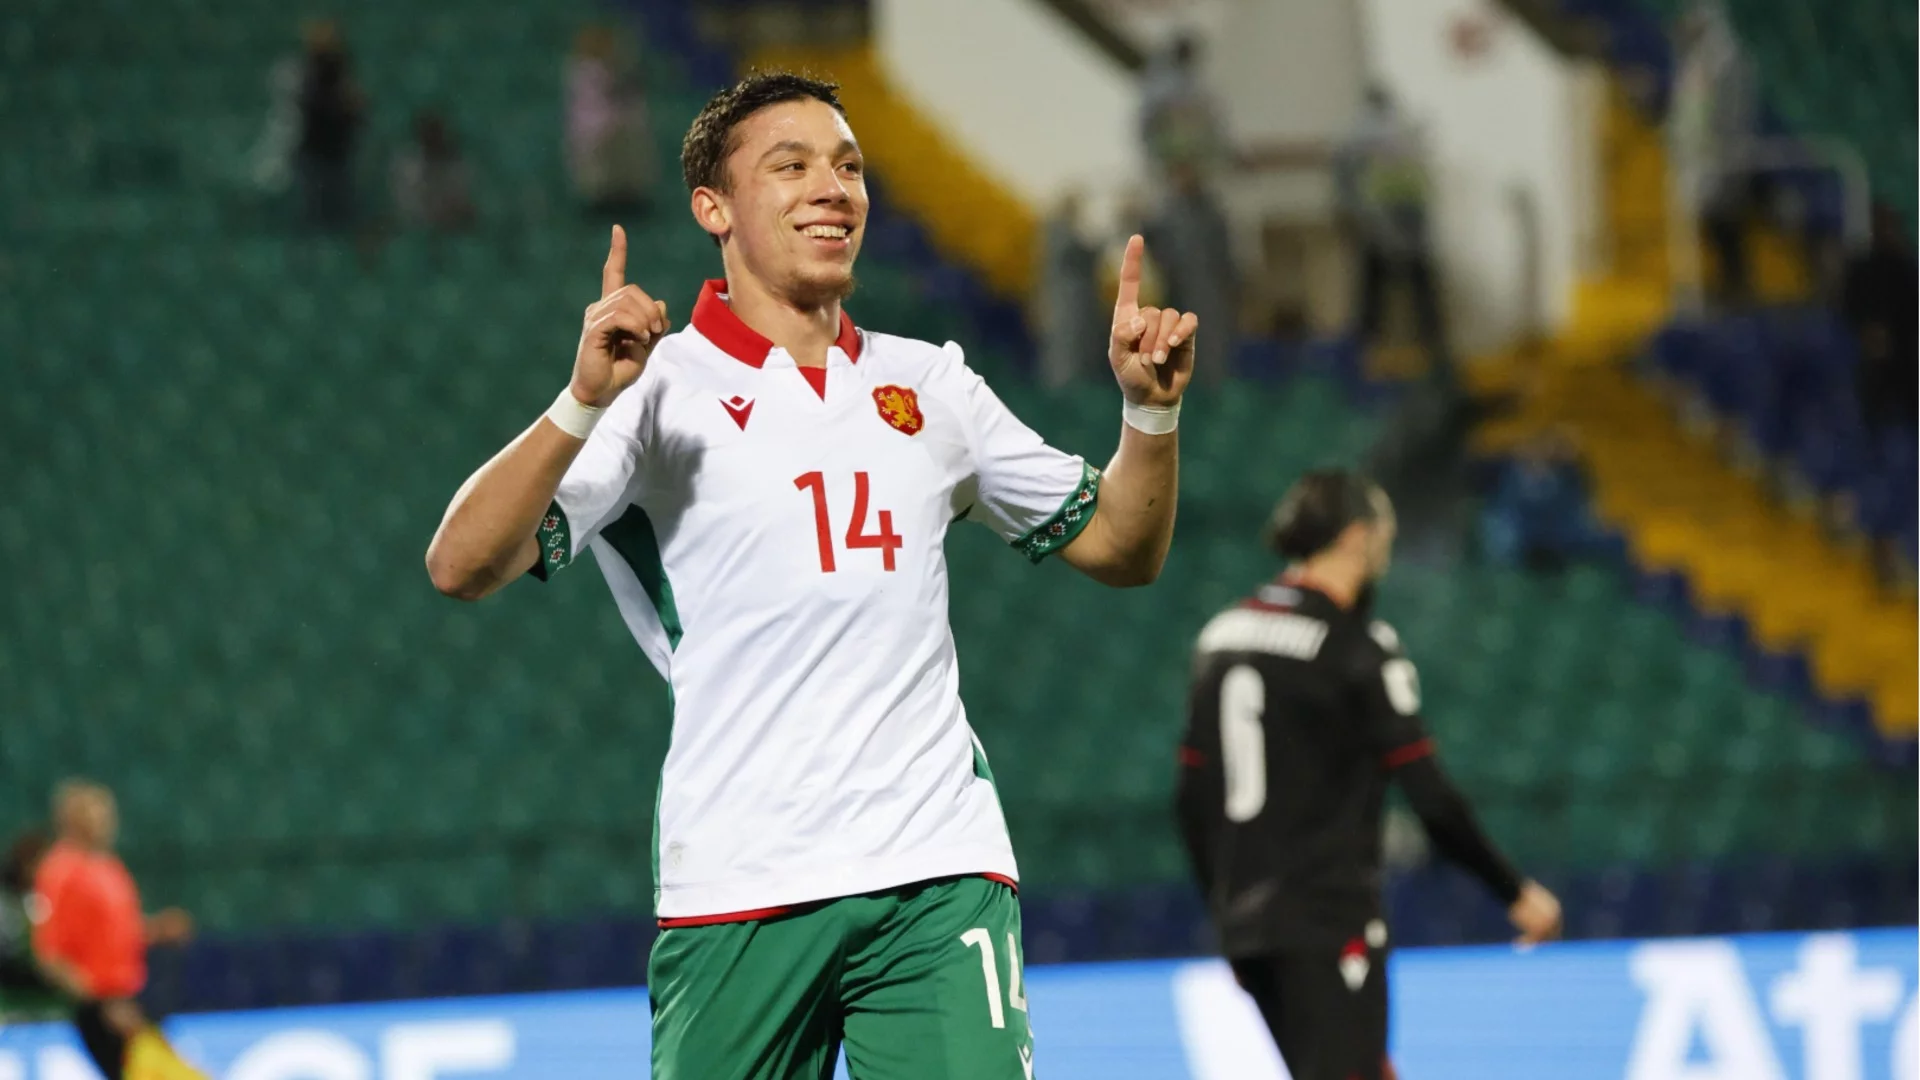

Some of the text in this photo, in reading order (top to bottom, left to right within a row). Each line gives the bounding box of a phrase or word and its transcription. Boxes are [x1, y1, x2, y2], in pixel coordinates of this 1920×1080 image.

[793, 471, 903, 573] 14
[1219, 664, 1267, 823] 6
[1624, 933, 1919, 1080] At
